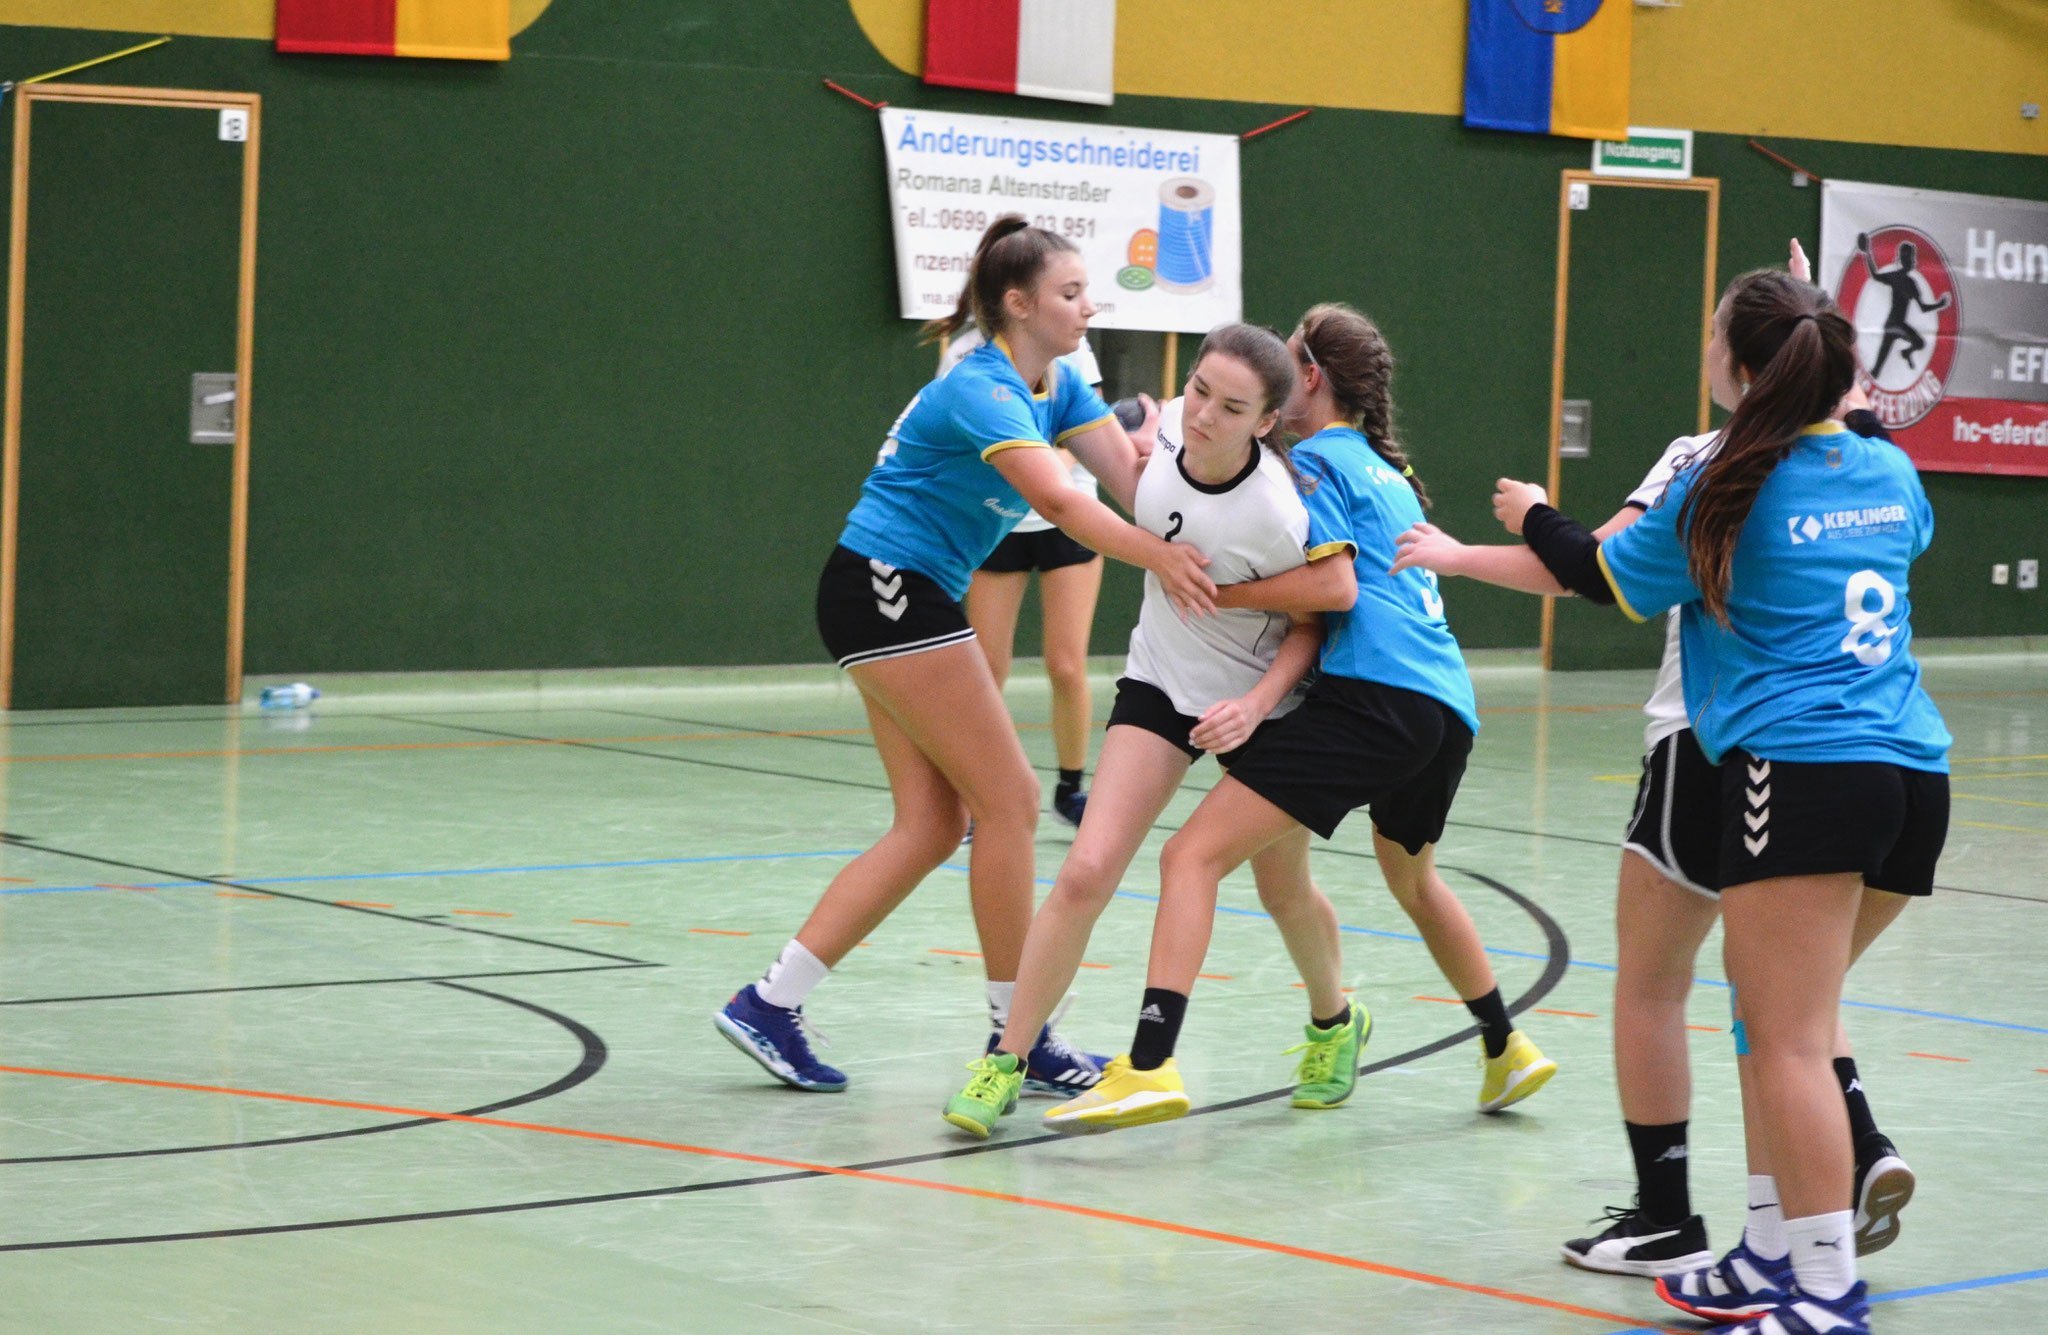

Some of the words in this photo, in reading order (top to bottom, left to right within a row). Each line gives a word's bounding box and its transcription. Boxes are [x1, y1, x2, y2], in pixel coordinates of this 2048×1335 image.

[898, 115, 1200, 173] Änderungsschneiderei
[1604, 142, 1681, 163] Notausgang
[897, 168, 981, 195] Romana
[988, 174, 1111, 203] Altenstraßer
[900, 206, 987, 232] el.:0699
[1064, 216, 1096, 239] 951
[1966, 228, 2048, 283] Han
[1823, 504, 1908, 530] KEPLINGER
[1840, 569, 1899, 667] 8
